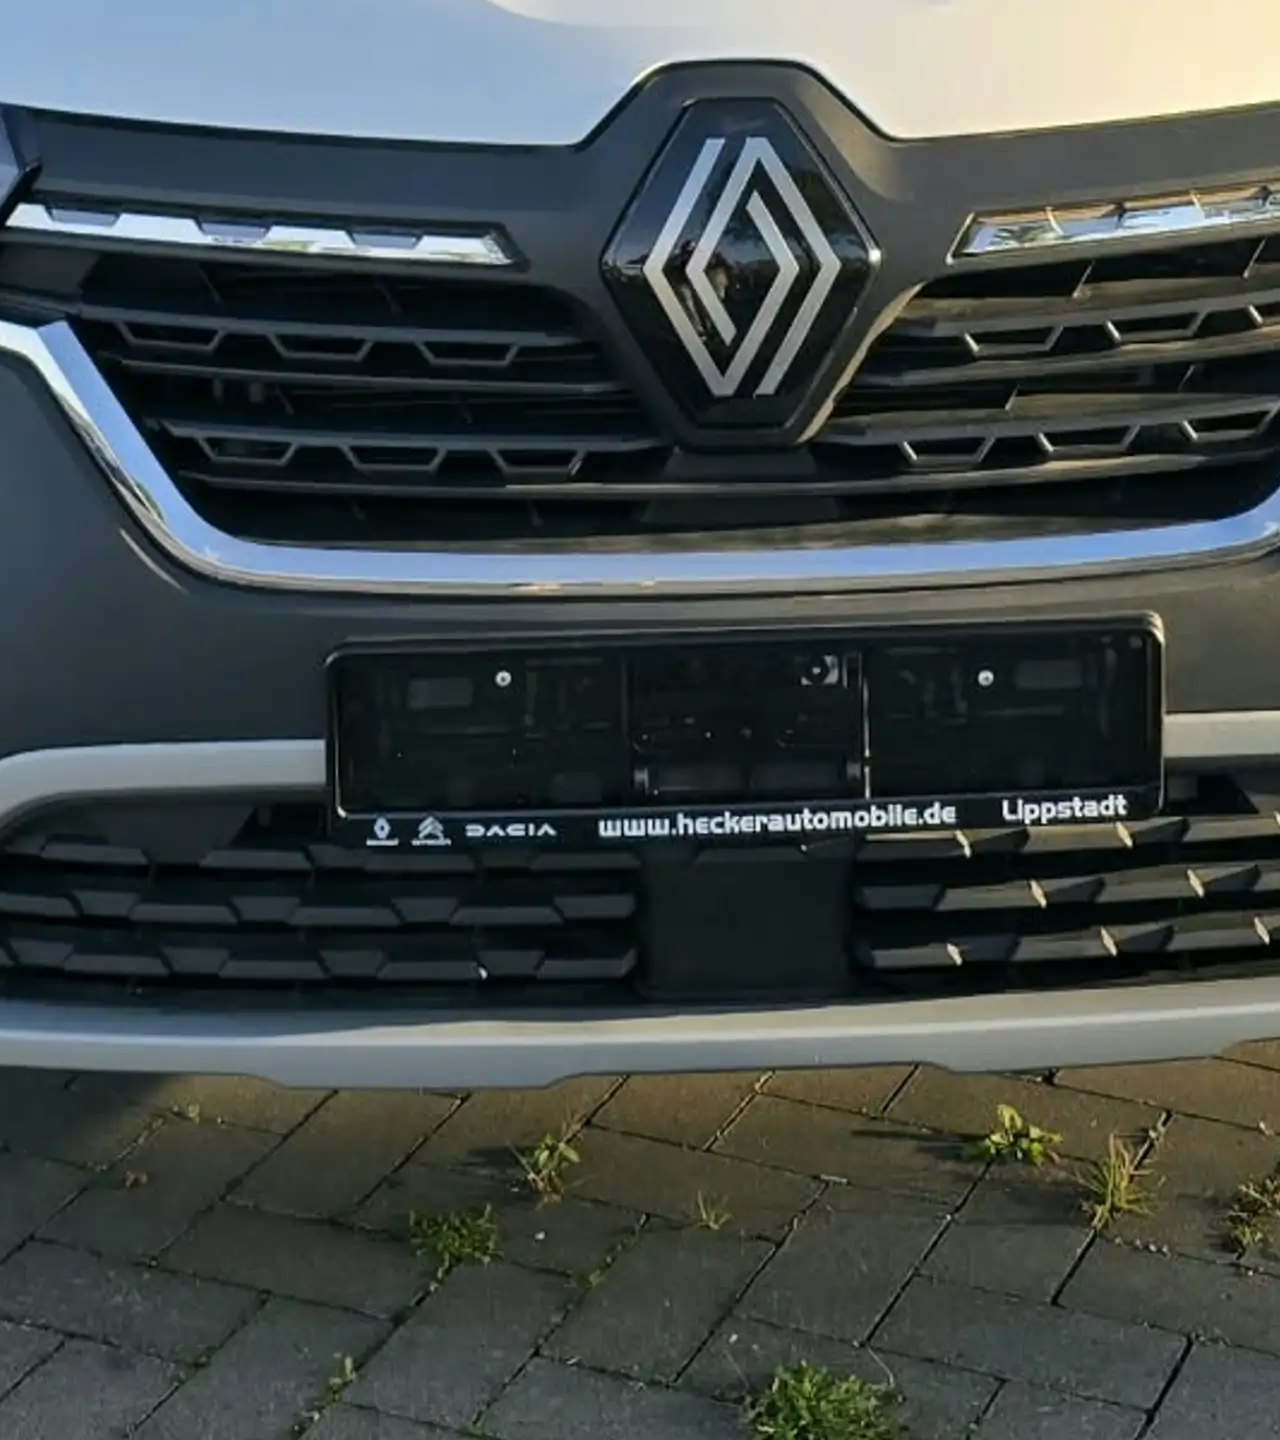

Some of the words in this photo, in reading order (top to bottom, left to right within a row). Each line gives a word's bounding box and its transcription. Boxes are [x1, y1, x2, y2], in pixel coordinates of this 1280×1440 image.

[464, 822, 558, 837] DACIA
[597, 801, 958, 838] www.heckerautomobile.de
[1001, 793, 1128, 825] Lippstadt
